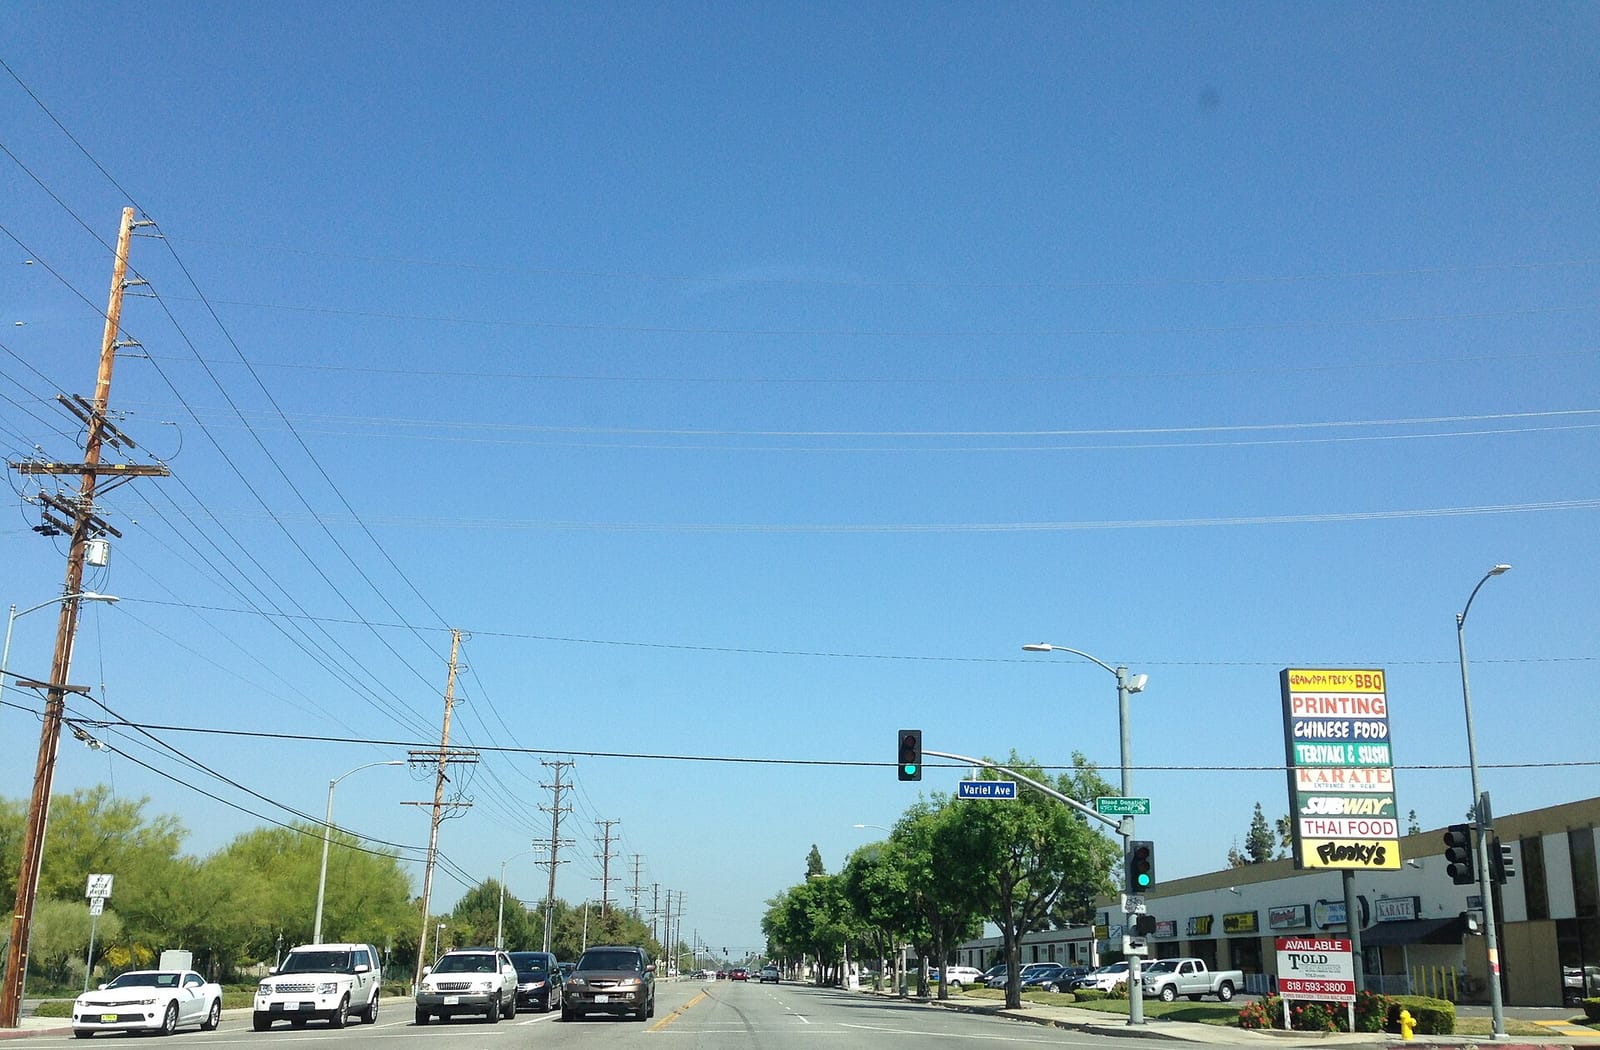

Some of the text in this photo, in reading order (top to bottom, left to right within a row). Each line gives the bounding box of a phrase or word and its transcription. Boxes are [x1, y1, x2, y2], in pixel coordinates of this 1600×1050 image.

[1290, 674, 1382, 690] GRANDPA FRED'S BBQ
[1293, 697, 1385, 714] PRINTING
[1295, 721, 1387, 738] CHINESE FOOD
[1297, 745, 1390, 763] TERIYAKI & SUSHI
[1300, 769, 1391, 783] KARATE
[963, 784, 1011, 796] Variel Ave
[1301, 797, 1392, 815] SUBWAY
[1305, 821, 1394, 835] THAI FOOD
[1379, 903, 1411, 916] KARATE
[1285, 941, 1342, 951] AVAILABLE
[1288, 954, 1328, 970] TOLD
